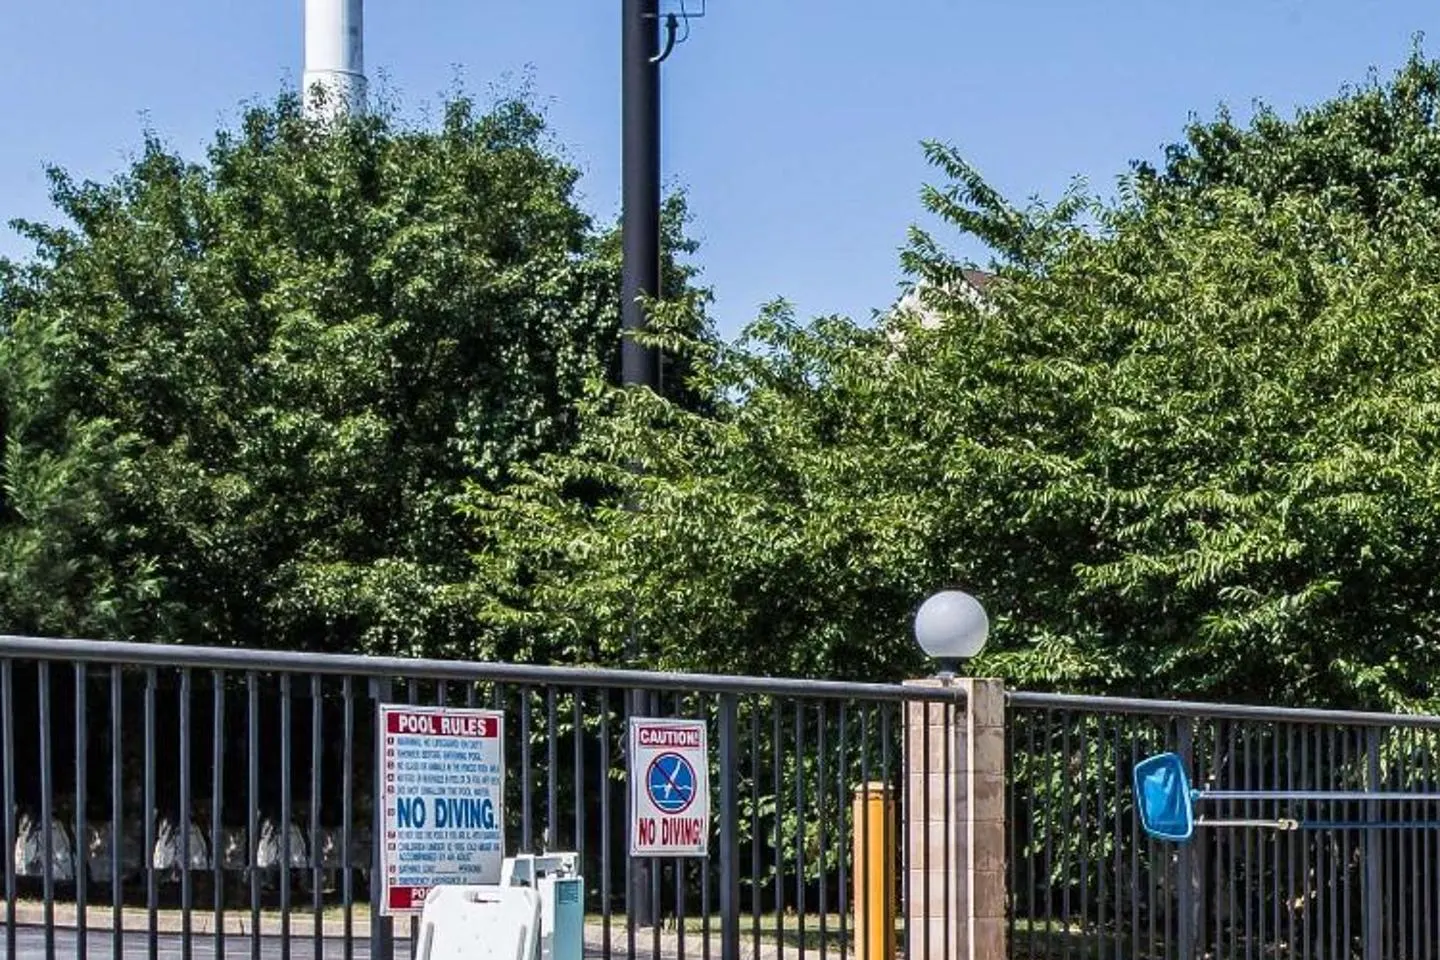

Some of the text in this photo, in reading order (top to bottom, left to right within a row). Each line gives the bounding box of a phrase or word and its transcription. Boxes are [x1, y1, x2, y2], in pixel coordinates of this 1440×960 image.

[399, 715, 487, 736] POOL RULES
[640, 729, 700, 746] CAUTION!
[397, 797, 499, 830] NO DIVING.
[638, 817, 703, 846] NO DIVING!
[411, 888, 429, 900] PO
